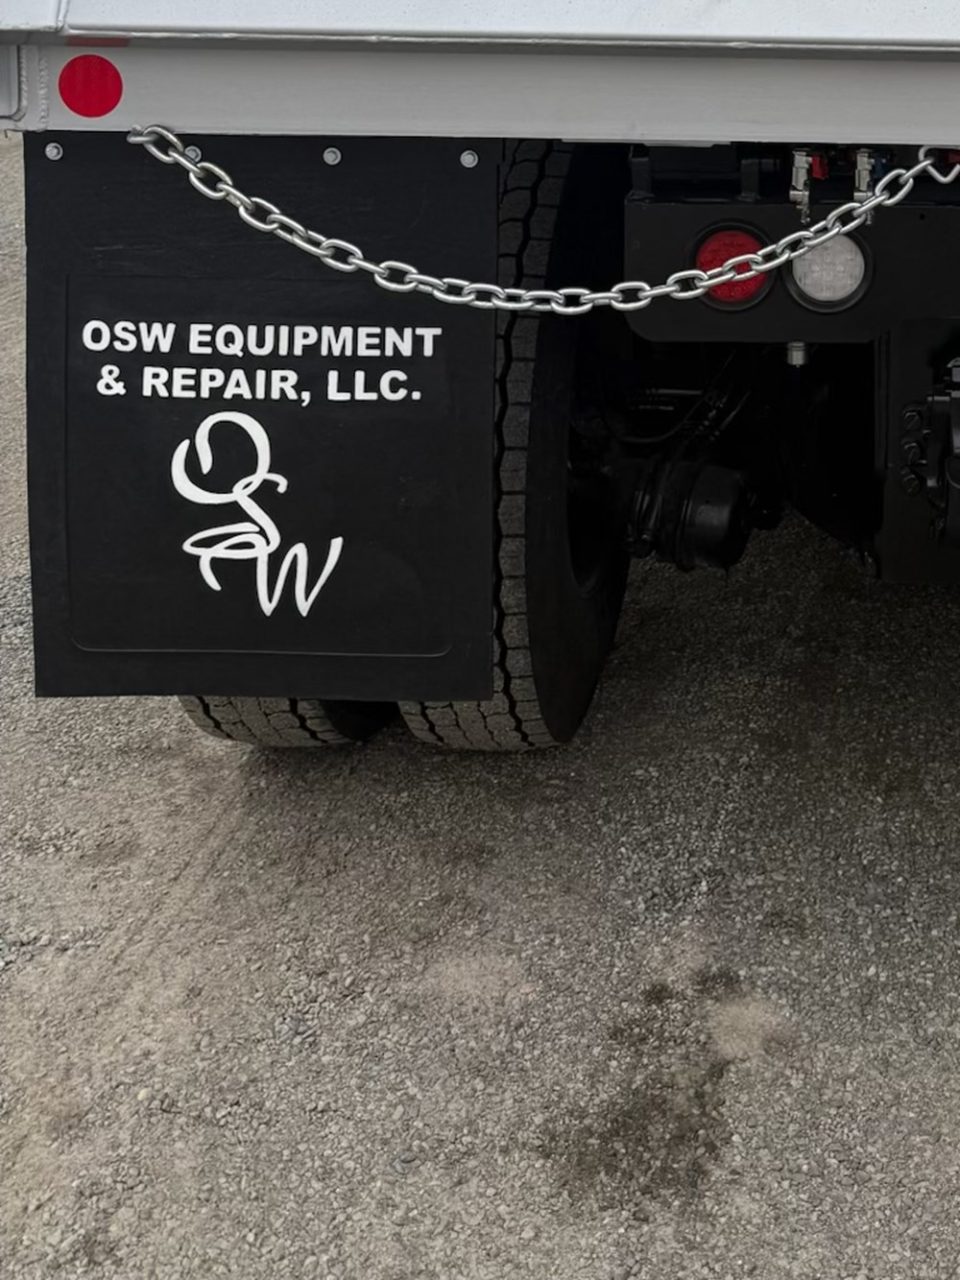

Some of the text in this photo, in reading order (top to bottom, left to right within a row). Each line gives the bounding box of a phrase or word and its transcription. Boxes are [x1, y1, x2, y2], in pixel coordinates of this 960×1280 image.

[83, 320, 442, 357] OSW EQUIPMENT
[97, 365, 421, 406] & REPAIR, LLC.
